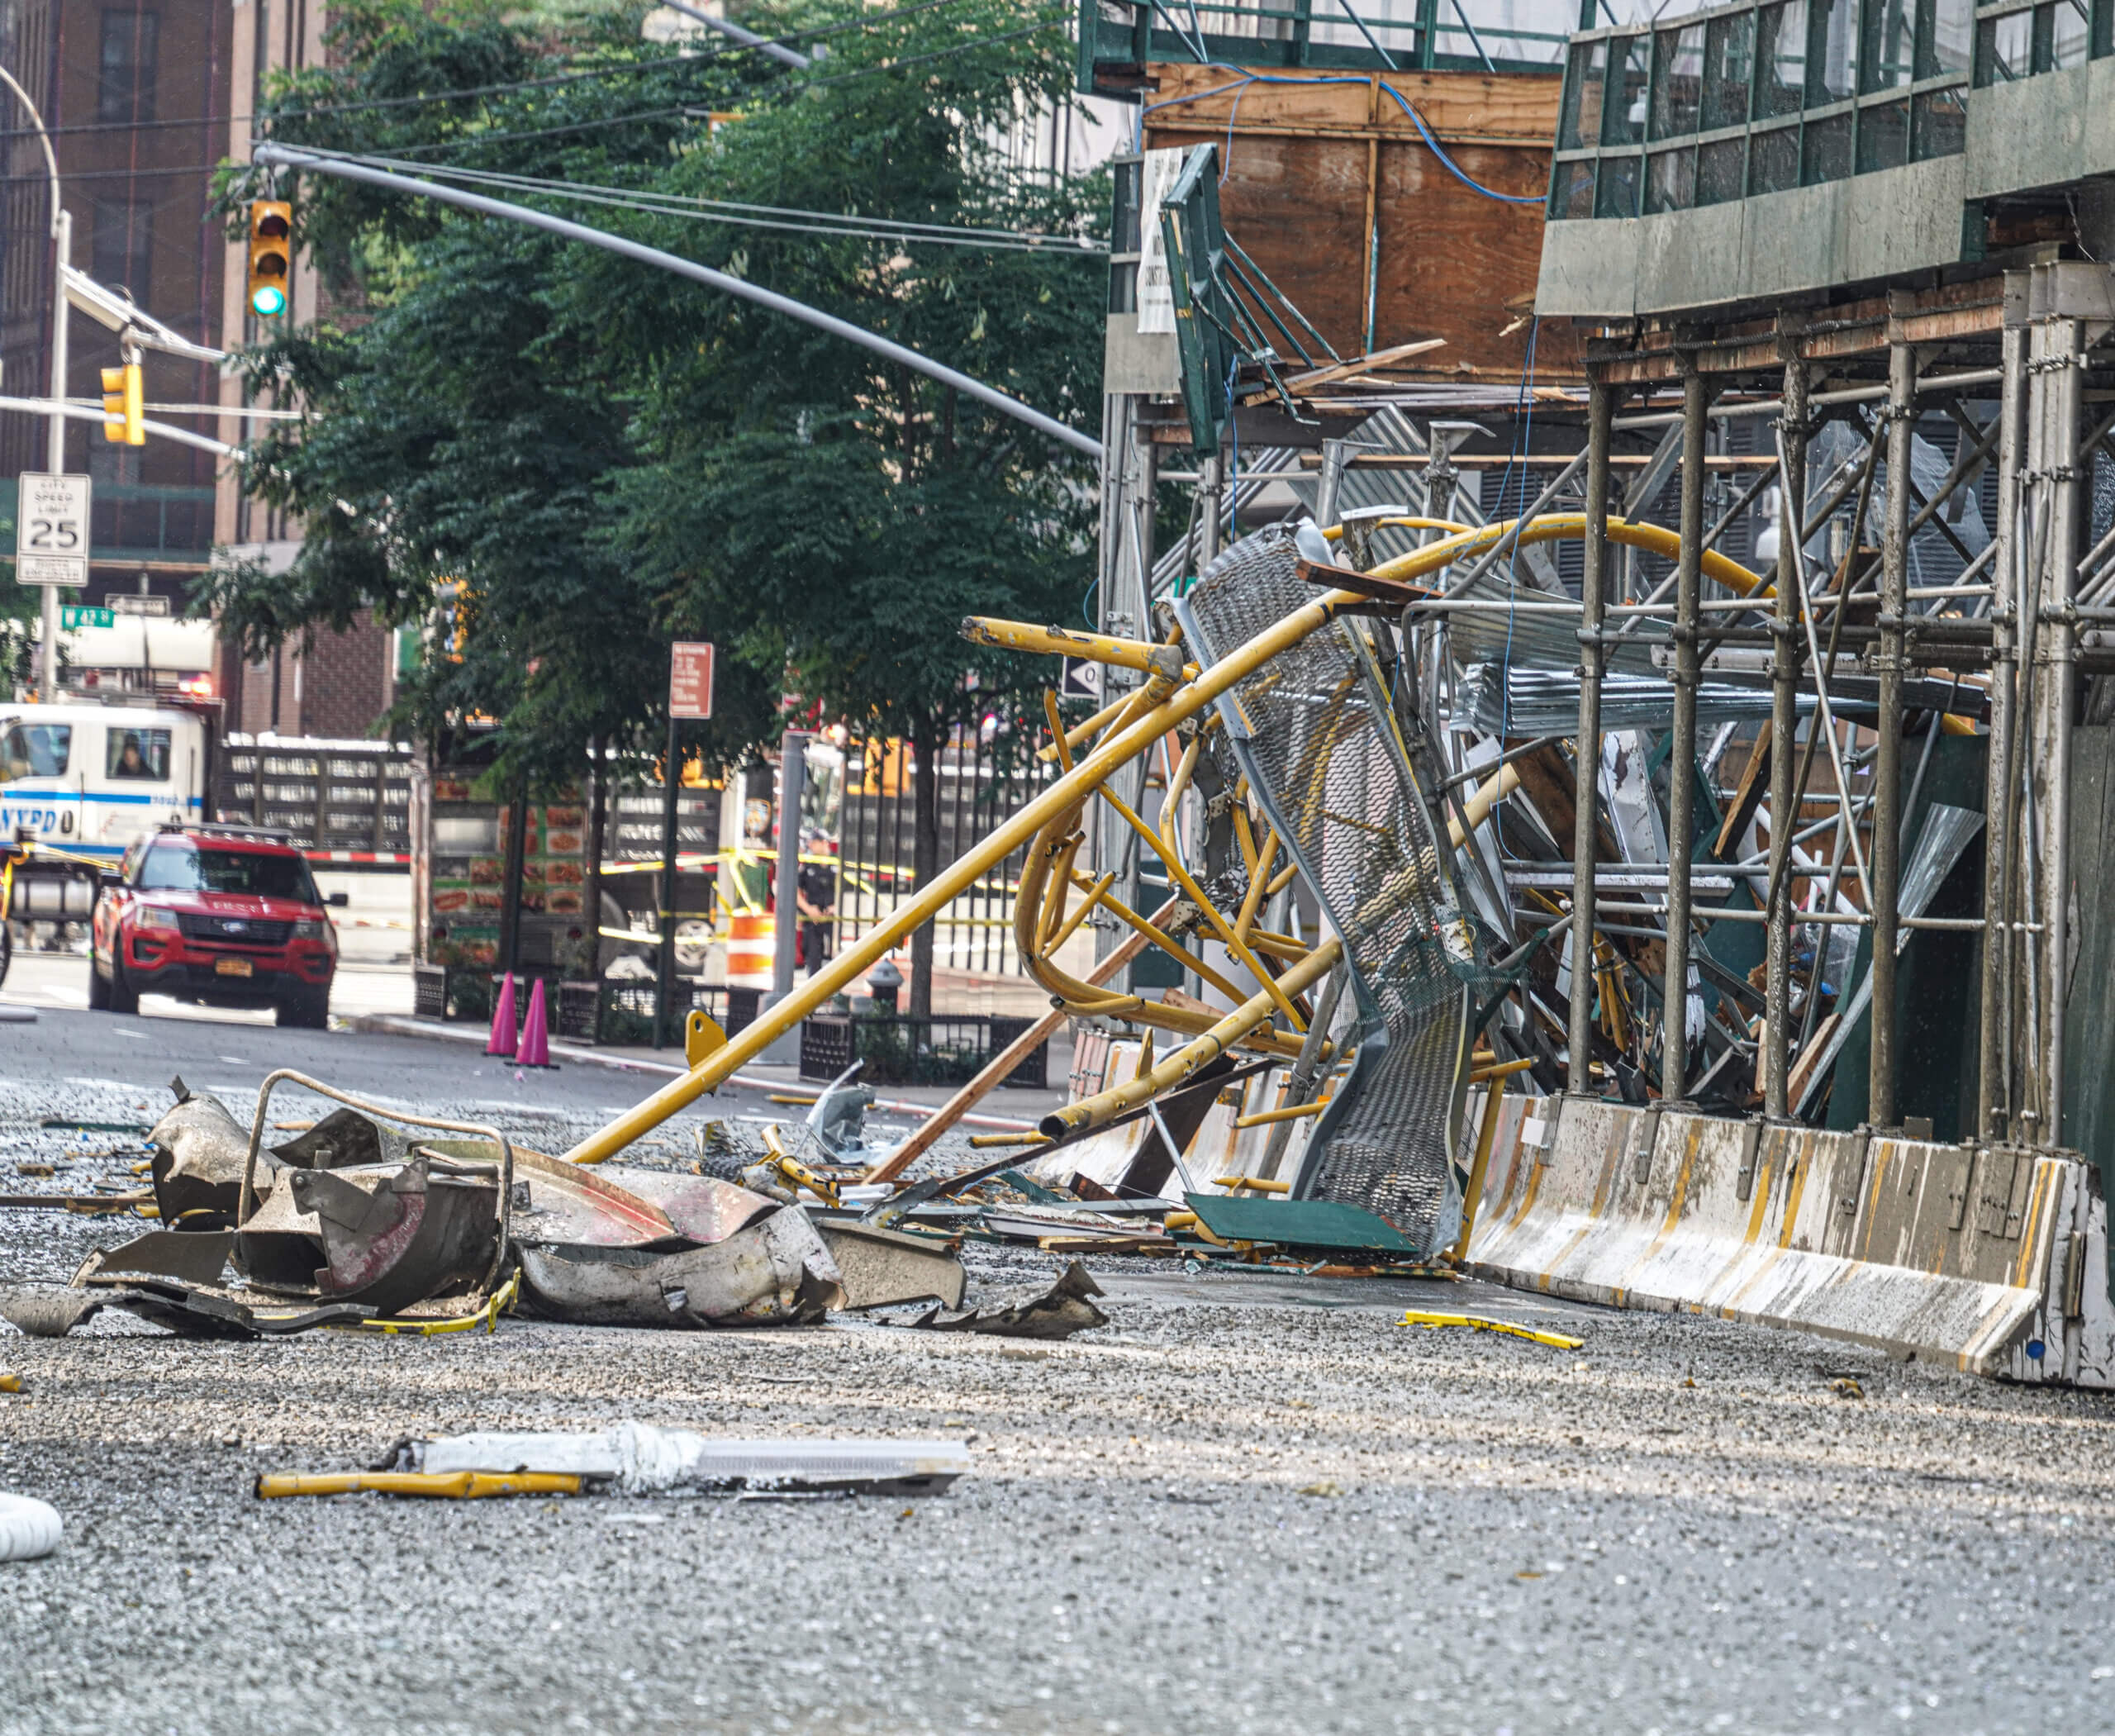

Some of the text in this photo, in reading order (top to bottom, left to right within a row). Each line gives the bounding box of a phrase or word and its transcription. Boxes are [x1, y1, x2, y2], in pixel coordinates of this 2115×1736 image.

[30, 518, 78, 549] 25
[64, 608, 76, 625] W
[2, 808, 57, 833] NYPD
